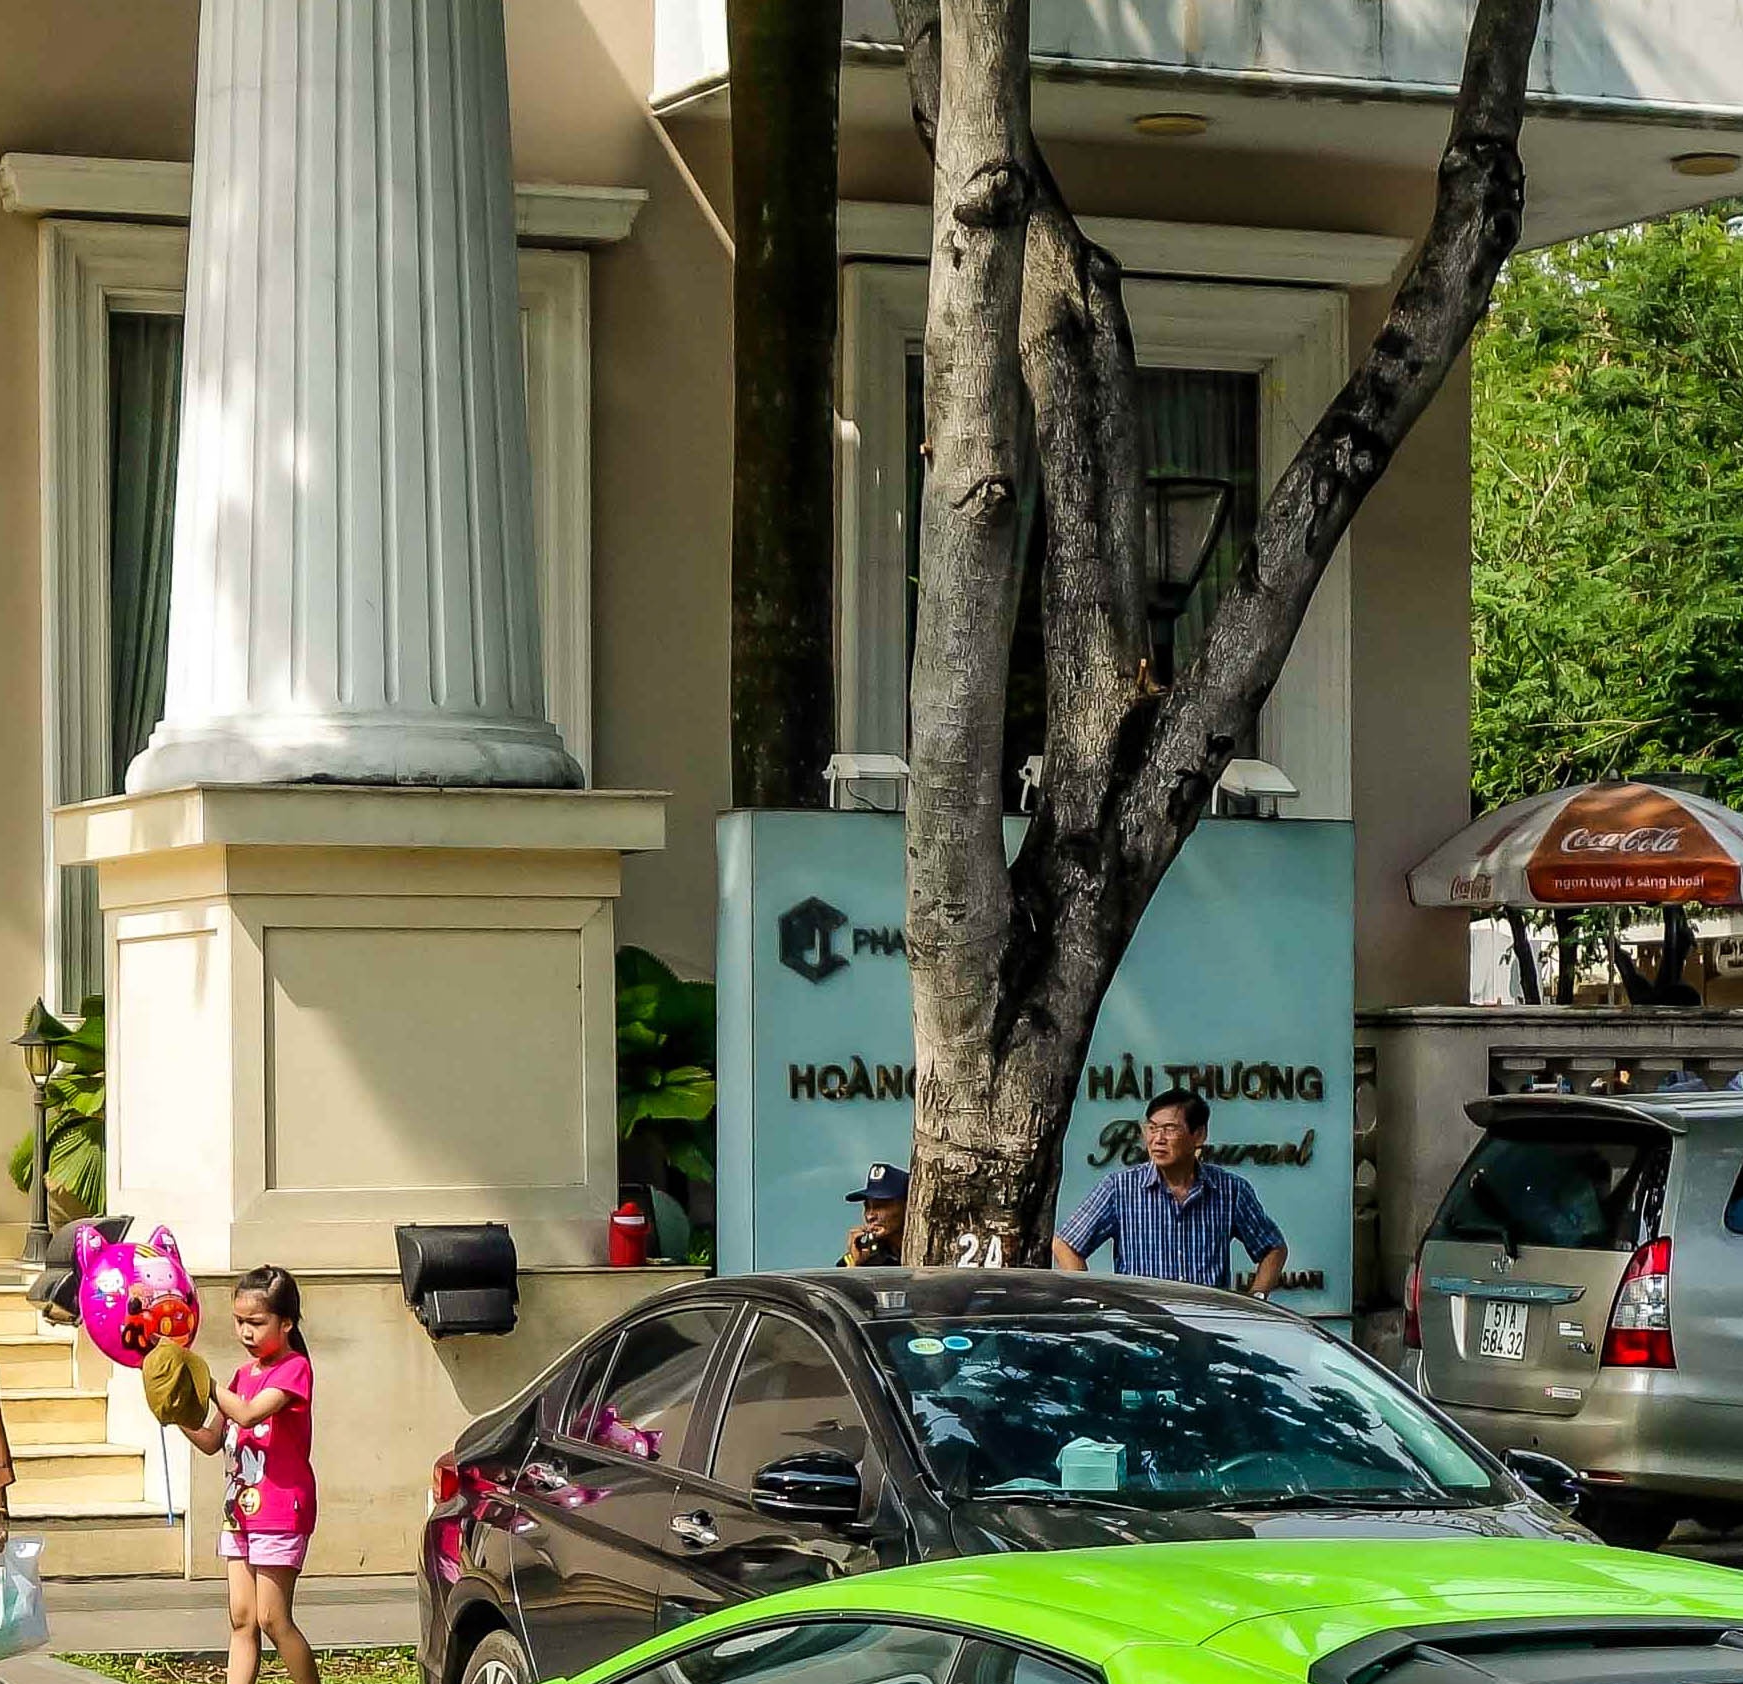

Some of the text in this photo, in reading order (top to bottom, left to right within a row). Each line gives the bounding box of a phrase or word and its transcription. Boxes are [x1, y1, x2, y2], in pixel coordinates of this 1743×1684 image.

[852, 926, 908, 957] PHA
[788, 1054, 916, 1101] HOÀN
[1087, 1052, 1153, 1101] HẢI
[1493, 1303, 1517, 1329] 51A
[1482, 1328, 1523, 1356] 584.32
